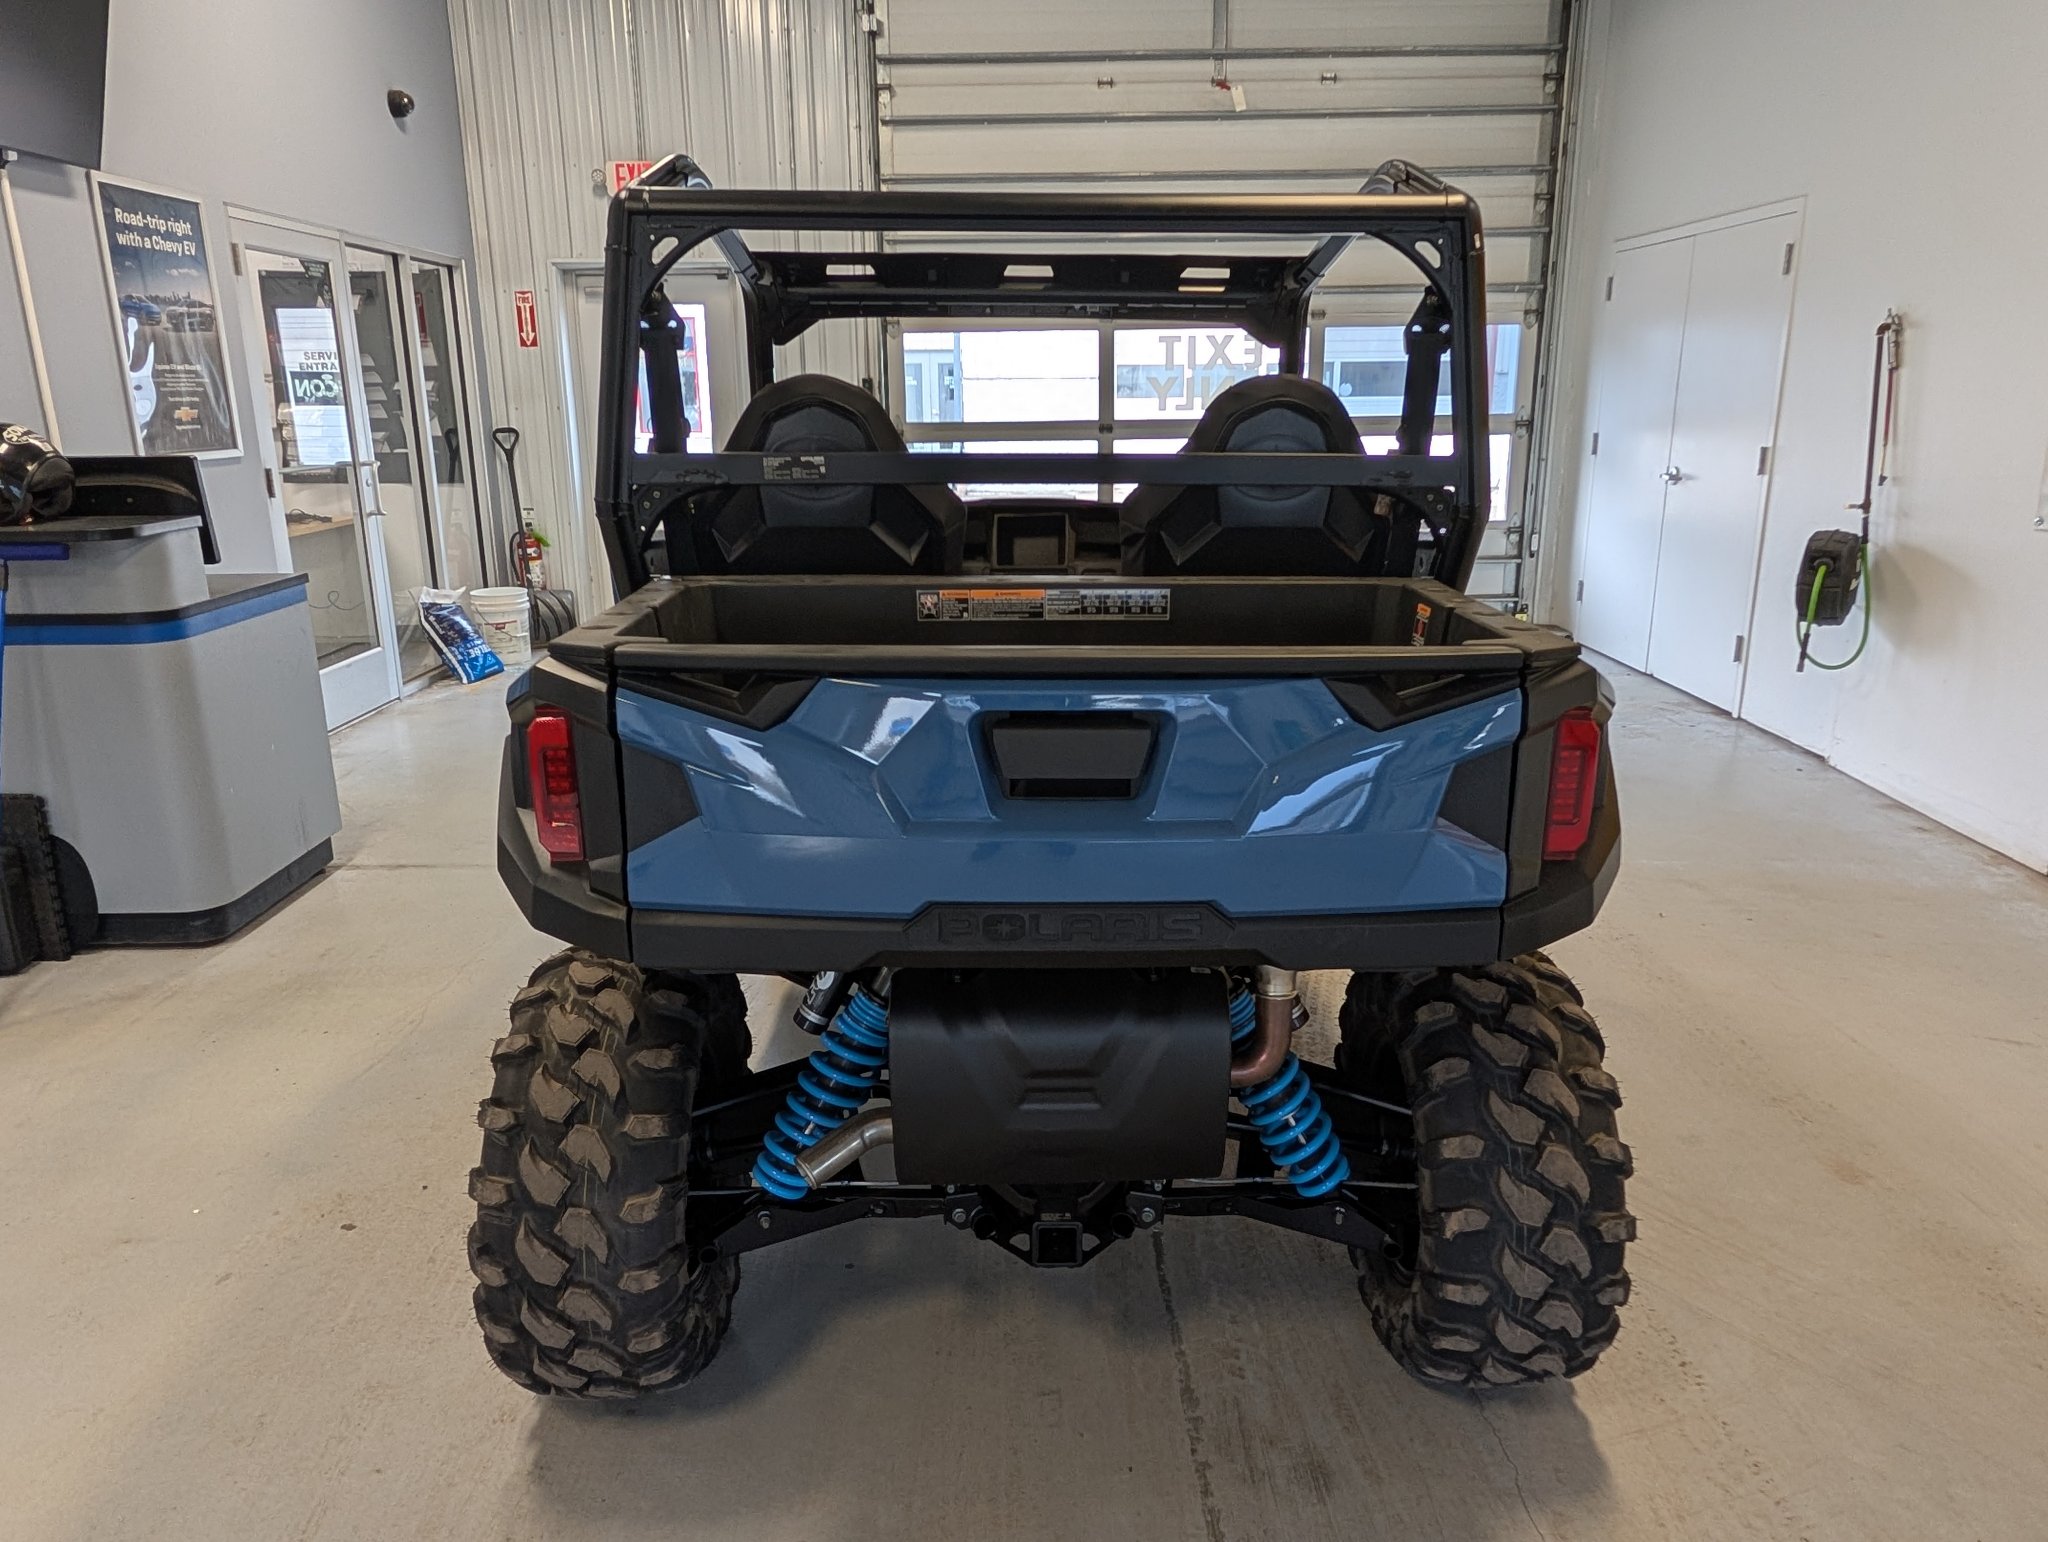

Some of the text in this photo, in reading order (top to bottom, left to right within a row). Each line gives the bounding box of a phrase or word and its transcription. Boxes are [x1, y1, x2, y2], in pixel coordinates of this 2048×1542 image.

[114, 207, 192, 236] Road-trip right
[116, 230, 196, 257] with a Chevy EV
[937, 911, 1203, 944] POLARIS
